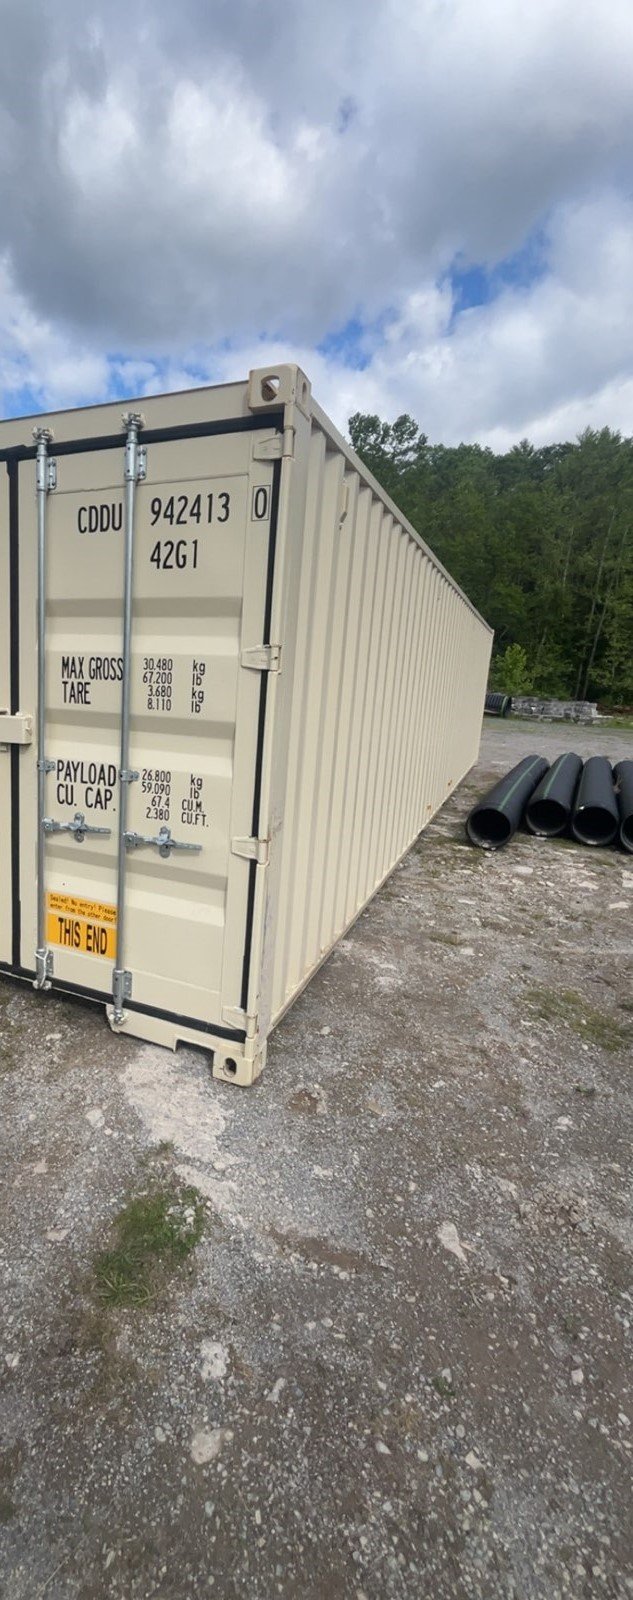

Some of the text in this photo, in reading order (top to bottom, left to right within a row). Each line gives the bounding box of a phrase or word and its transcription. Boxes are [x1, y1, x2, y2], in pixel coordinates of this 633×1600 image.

[77, 487, 268, 534] CDDU 942413 0
[150, 539, 198, 570] 42G1
[61, 656, 206, 681] MAX GROSS 30.480 kg
[142, 671, 203, 686] 67.200 lb
[62, 681, 204, 705] TARE 3.680 kg
[147, 698, 201, 713] 8.110 lb
[56, 759, 203, 790] PAYLOAD 26.800 kg
[56, 783, 204, 813] CU. CAP. 67.4 CU.M.
[141, 781, 200, 800] 59.090 lb
[146, 807, 209, 828] 2.380 CU.FT.
[58, 917, 107, 955] THIS END
